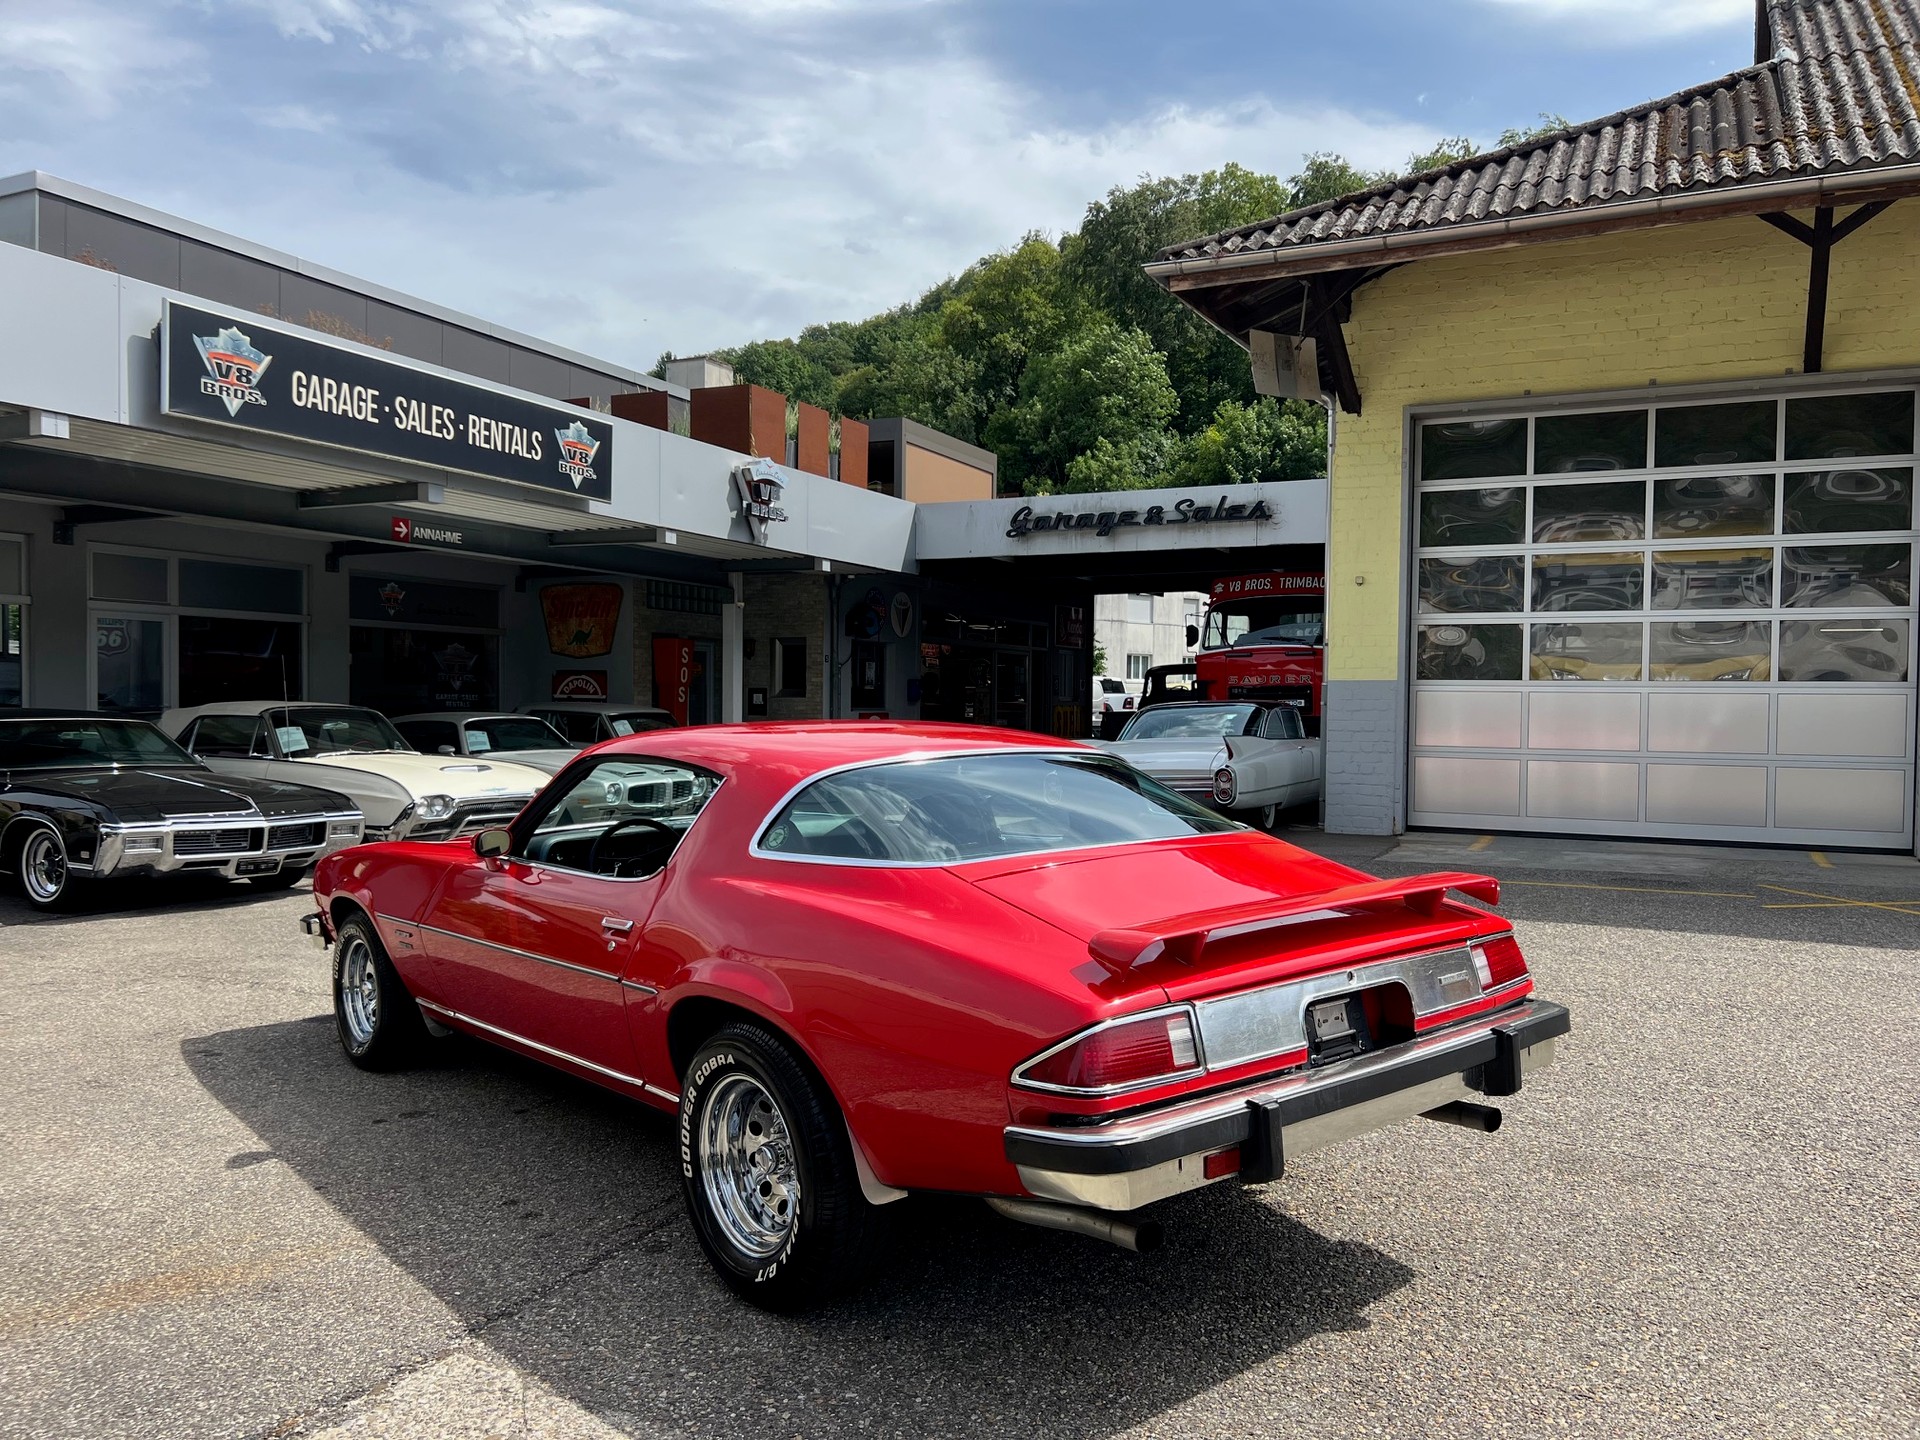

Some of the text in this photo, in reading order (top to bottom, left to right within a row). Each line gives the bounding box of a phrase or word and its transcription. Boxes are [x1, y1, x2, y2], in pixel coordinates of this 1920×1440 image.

[213, 360, 253, 386] V8
[201, 378, 267, 406] BROS.
[291, 370, 543, 461] GARAGE SALES RENTALS
[565, 446, 590, 465] V8
[559, 461, 597, 480] BROS.
[1006, 495, 1273, 538] Garage & Sales
[413, 526, 463, 545] ANNAHME
[1229, 581, 1241, 592] V8
[1245, 578, 1273, 591] BROS.
[97, 629, 122, 648] 66
[564, 678, 596, 694] DAPOLIN
[1228, 675, 1313, 685] SAURER
[682, 1053, 736, 1178] COOPER COBRA
[755, 1262, 778, 1283] G/T
